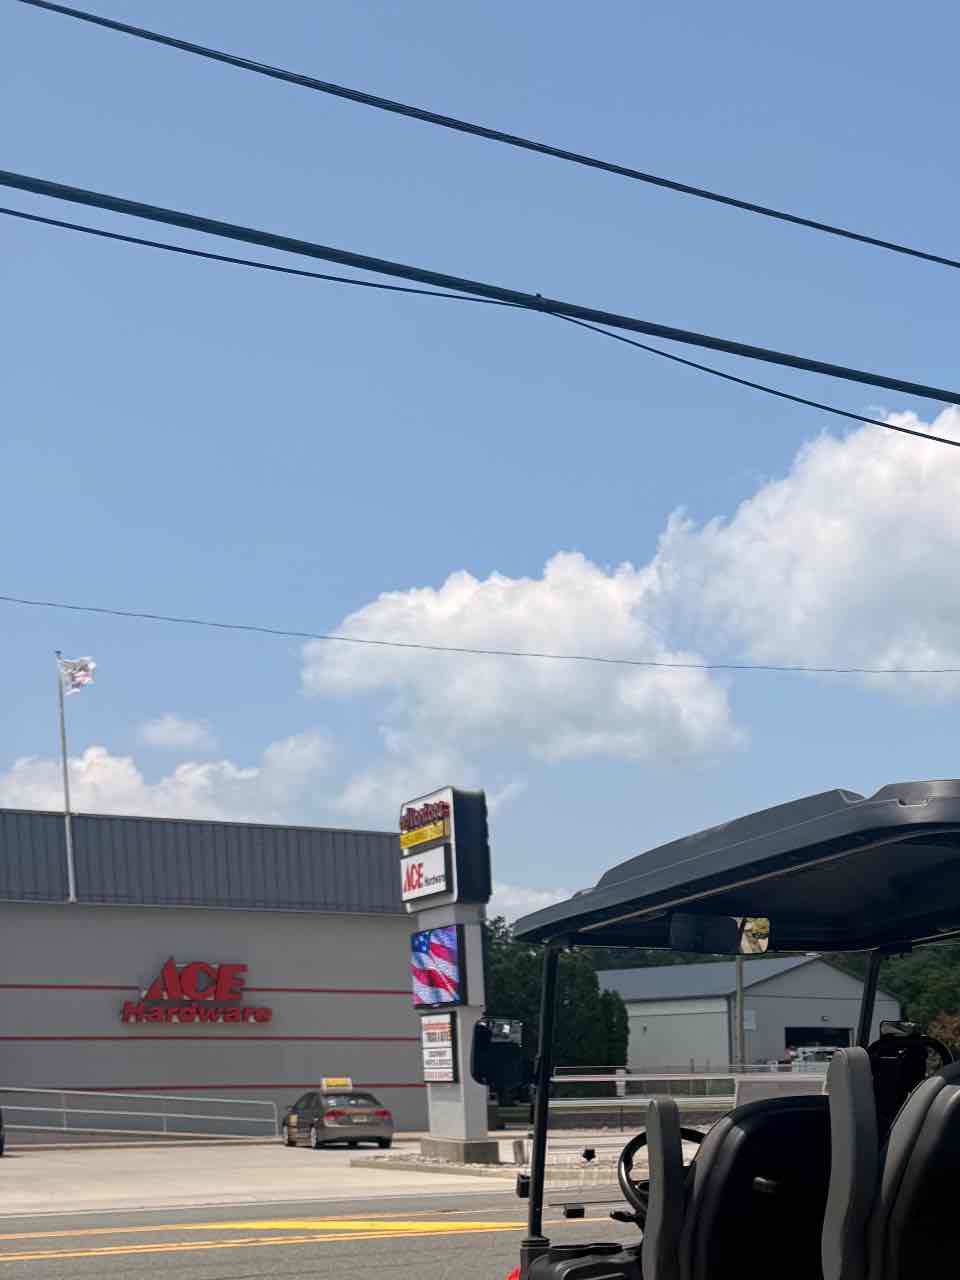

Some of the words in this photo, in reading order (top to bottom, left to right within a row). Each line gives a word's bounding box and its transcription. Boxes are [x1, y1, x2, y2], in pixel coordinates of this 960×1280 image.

[404, 863, 423, 893] ACE
[142, 959, 248, 1001] ACE
[121, 1000, 273, 1024] Hardware
